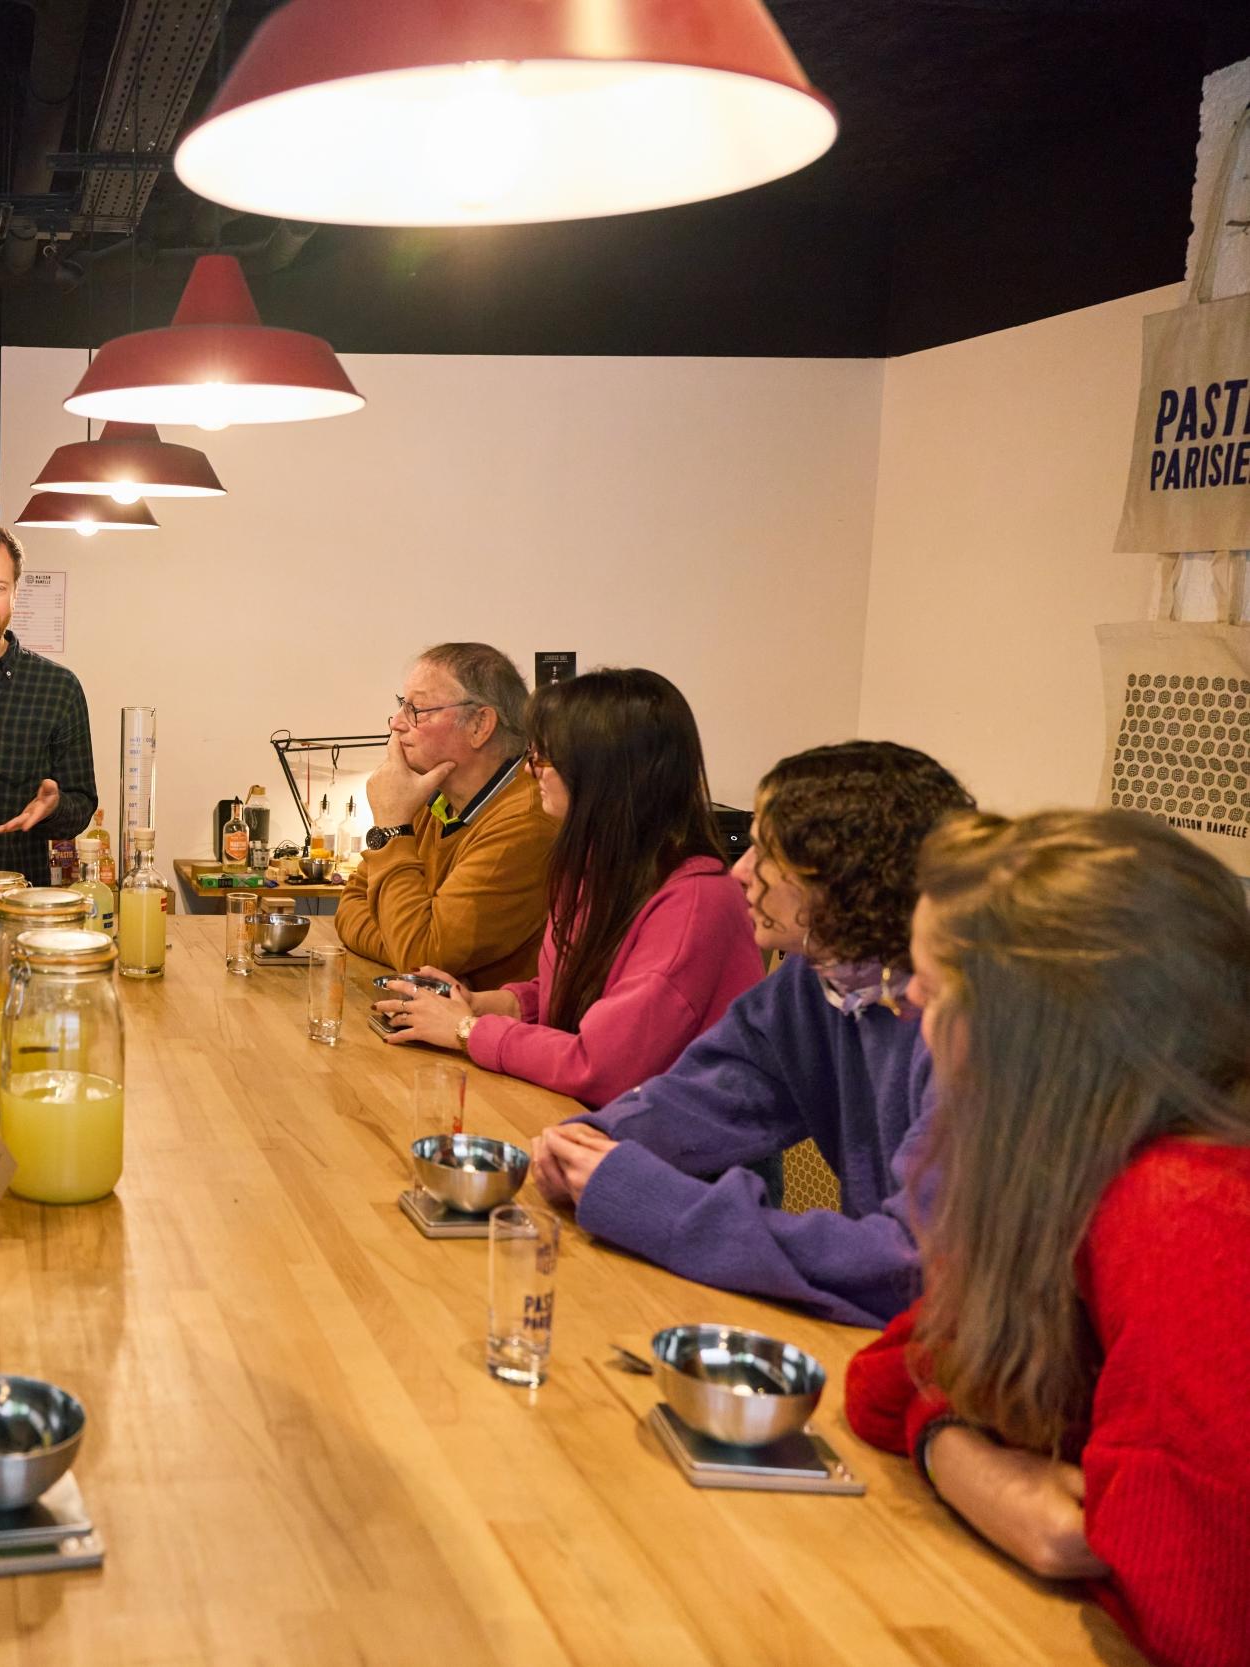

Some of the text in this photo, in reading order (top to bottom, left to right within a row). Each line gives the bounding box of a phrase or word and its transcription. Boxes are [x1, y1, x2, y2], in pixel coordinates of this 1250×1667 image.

[1150, 442, 1250, 491] PARISIE
[1168, 816, 1248, 838] MAISON HAMELLE
